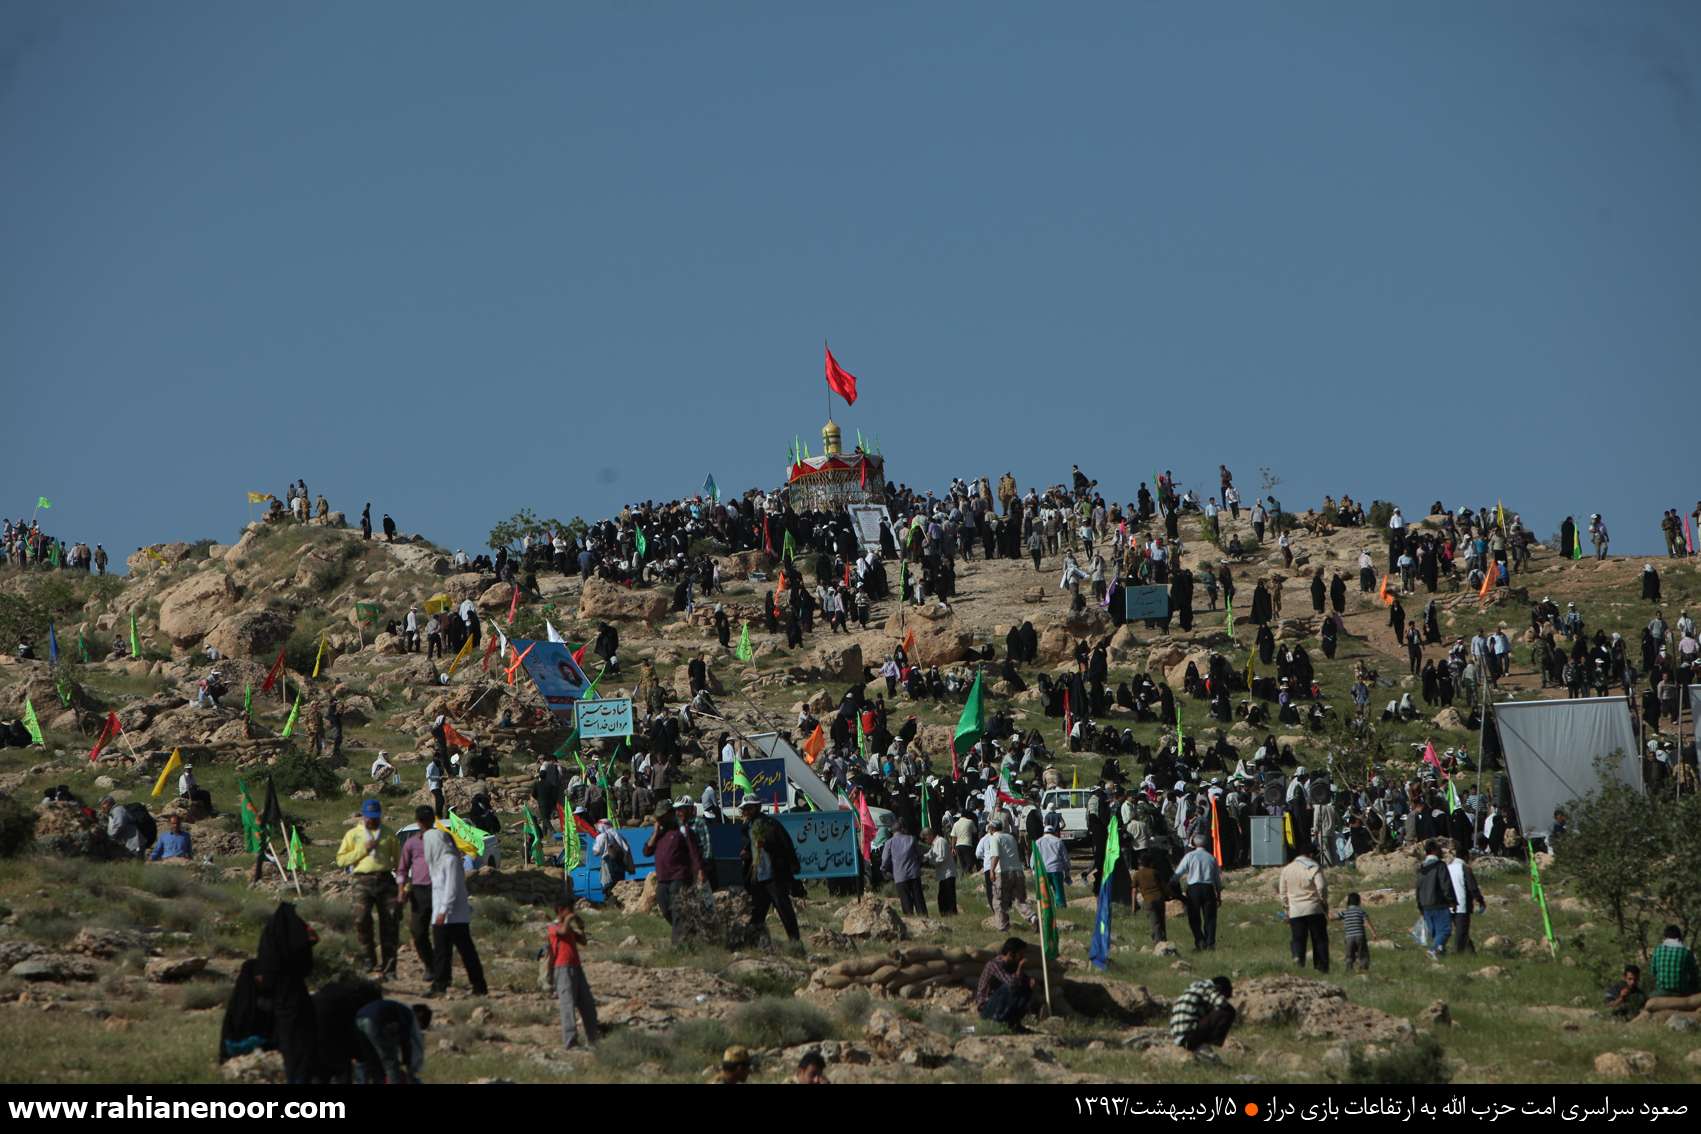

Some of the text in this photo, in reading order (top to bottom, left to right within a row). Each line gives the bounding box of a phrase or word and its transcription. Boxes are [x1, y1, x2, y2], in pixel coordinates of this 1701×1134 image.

[601, 700, 628, 716] شهادت
[583, 719, 628, 732] مردان خداست
[818, 819, 850, 842] عرفان
